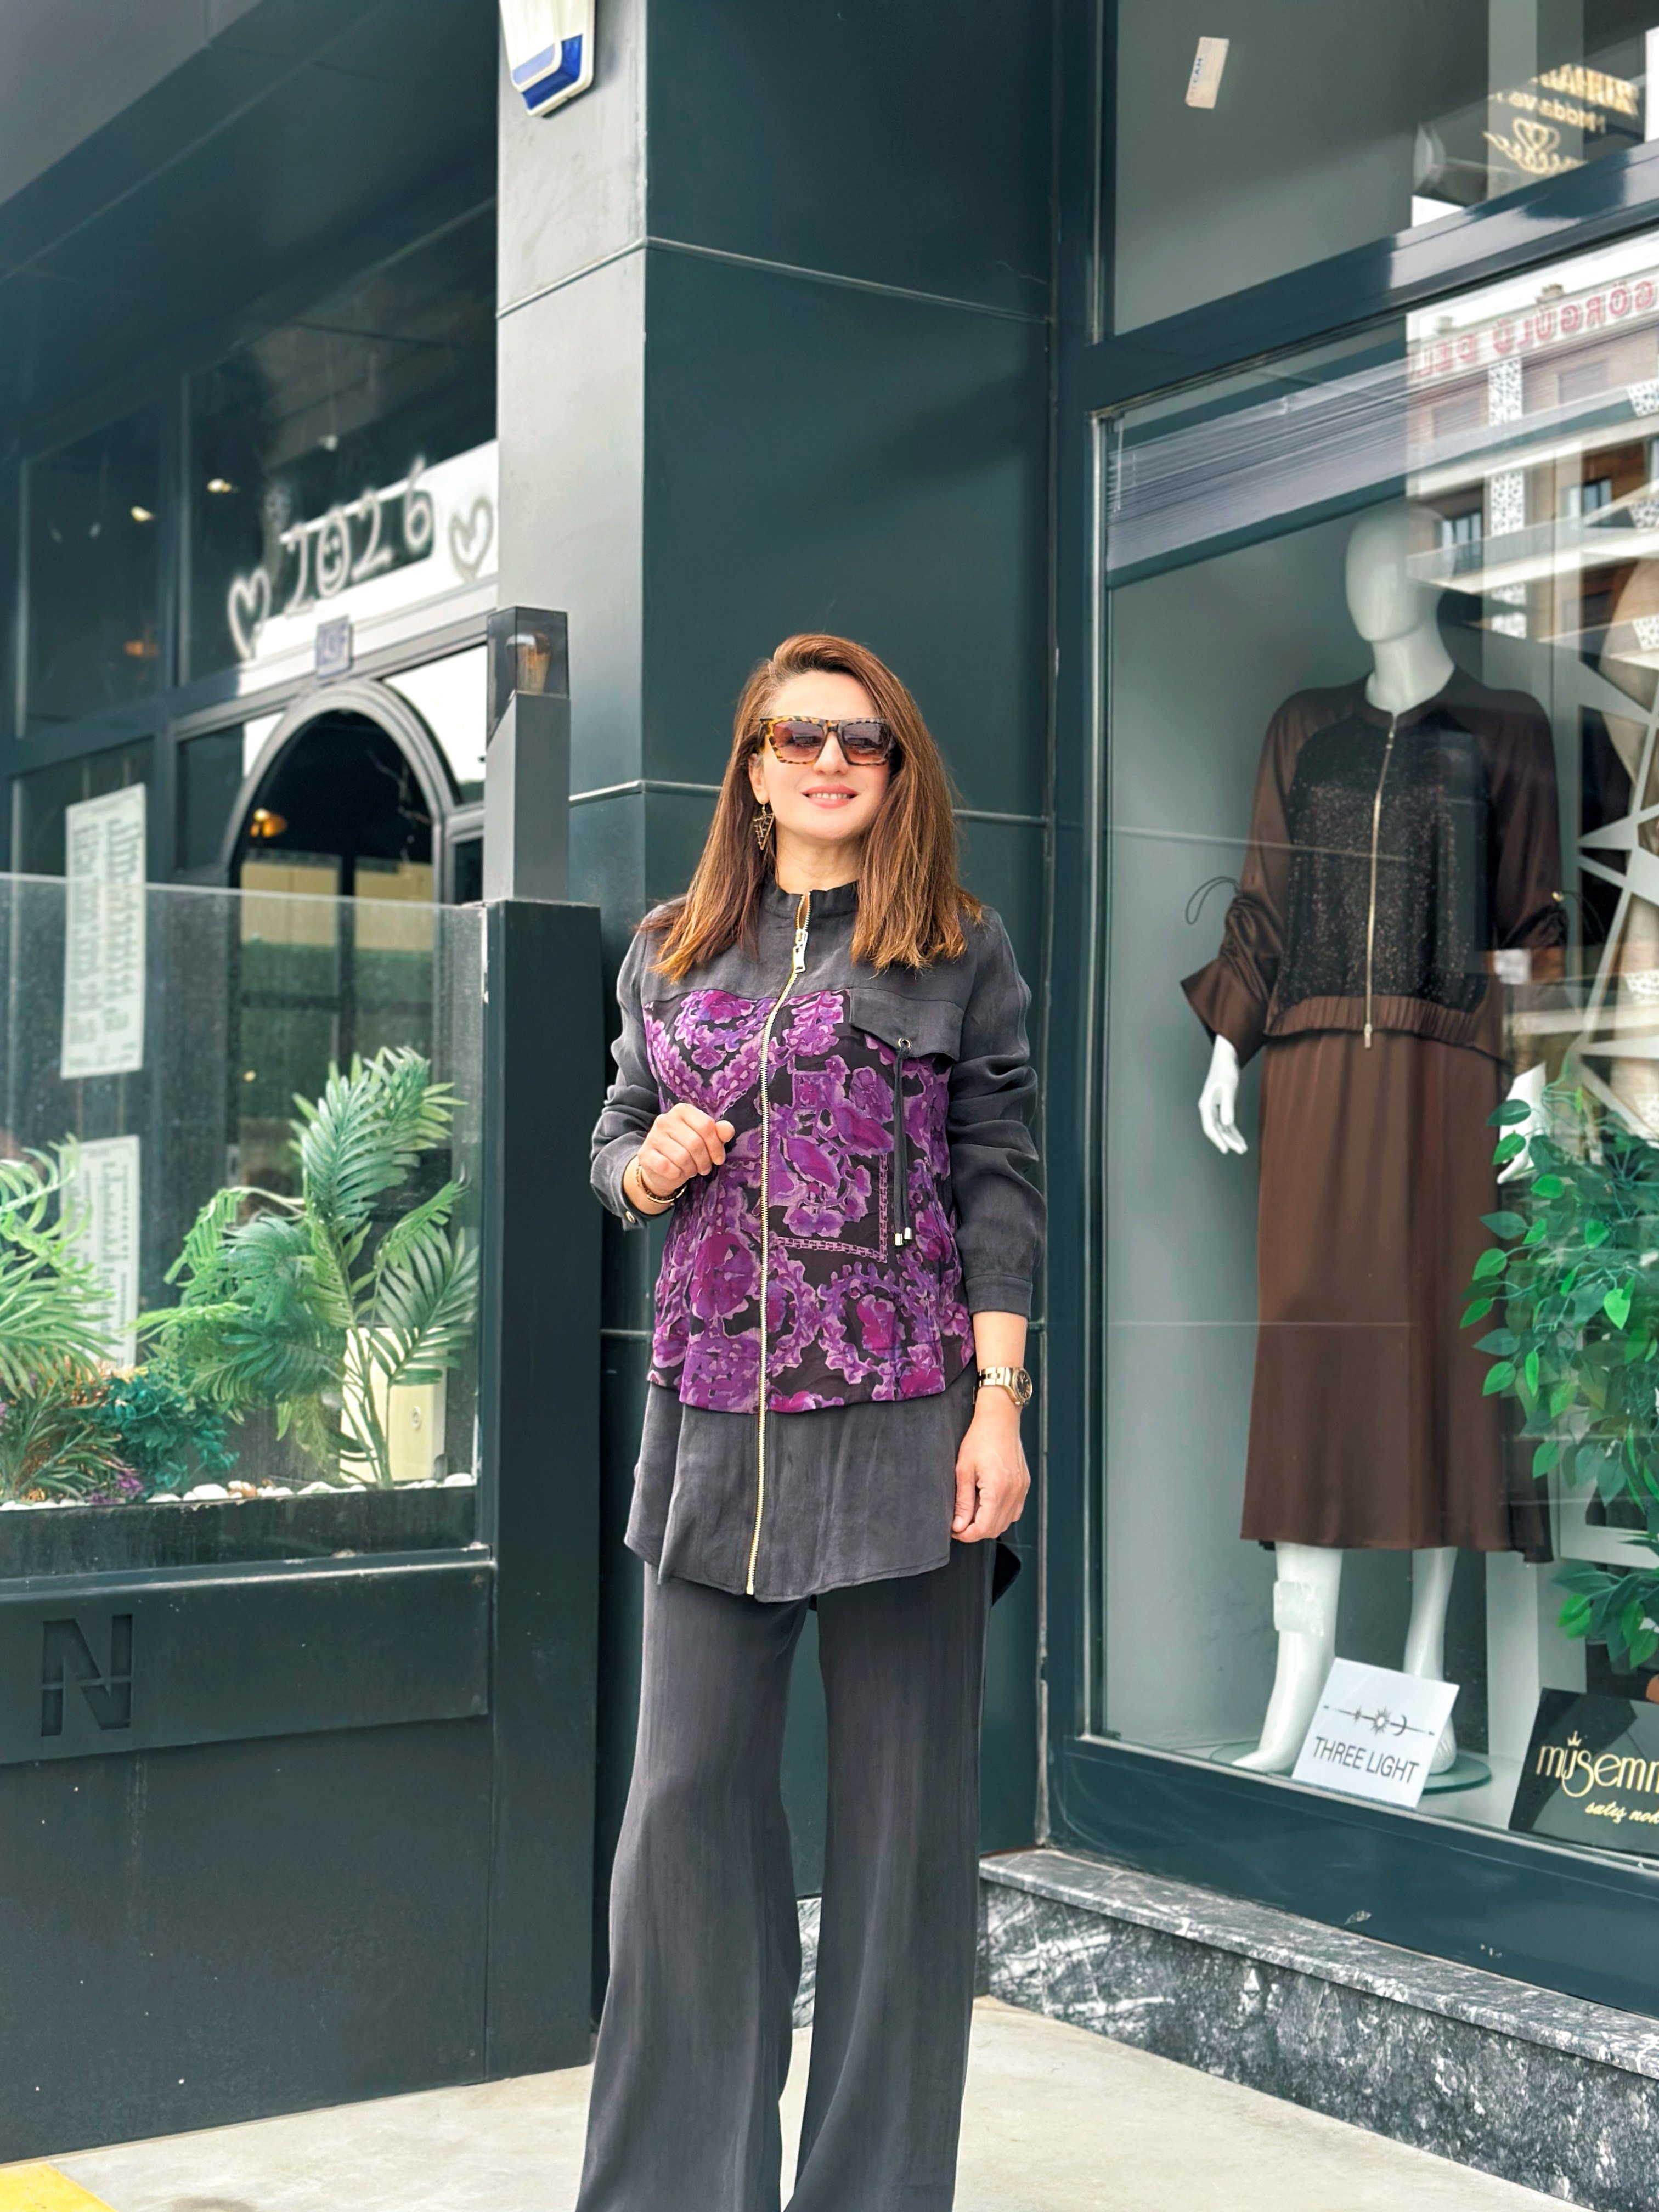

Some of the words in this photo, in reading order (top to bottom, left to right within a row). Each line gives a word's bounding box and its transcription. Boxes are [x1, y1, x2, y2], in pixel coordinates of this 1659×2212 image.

[284, 455, 432, 618] 2026
[41, 1613, 133, 1737] N
[1313, 1736, 1366, 1770] THREE
[1366, 1751, 1420, 1783] LIGHT
